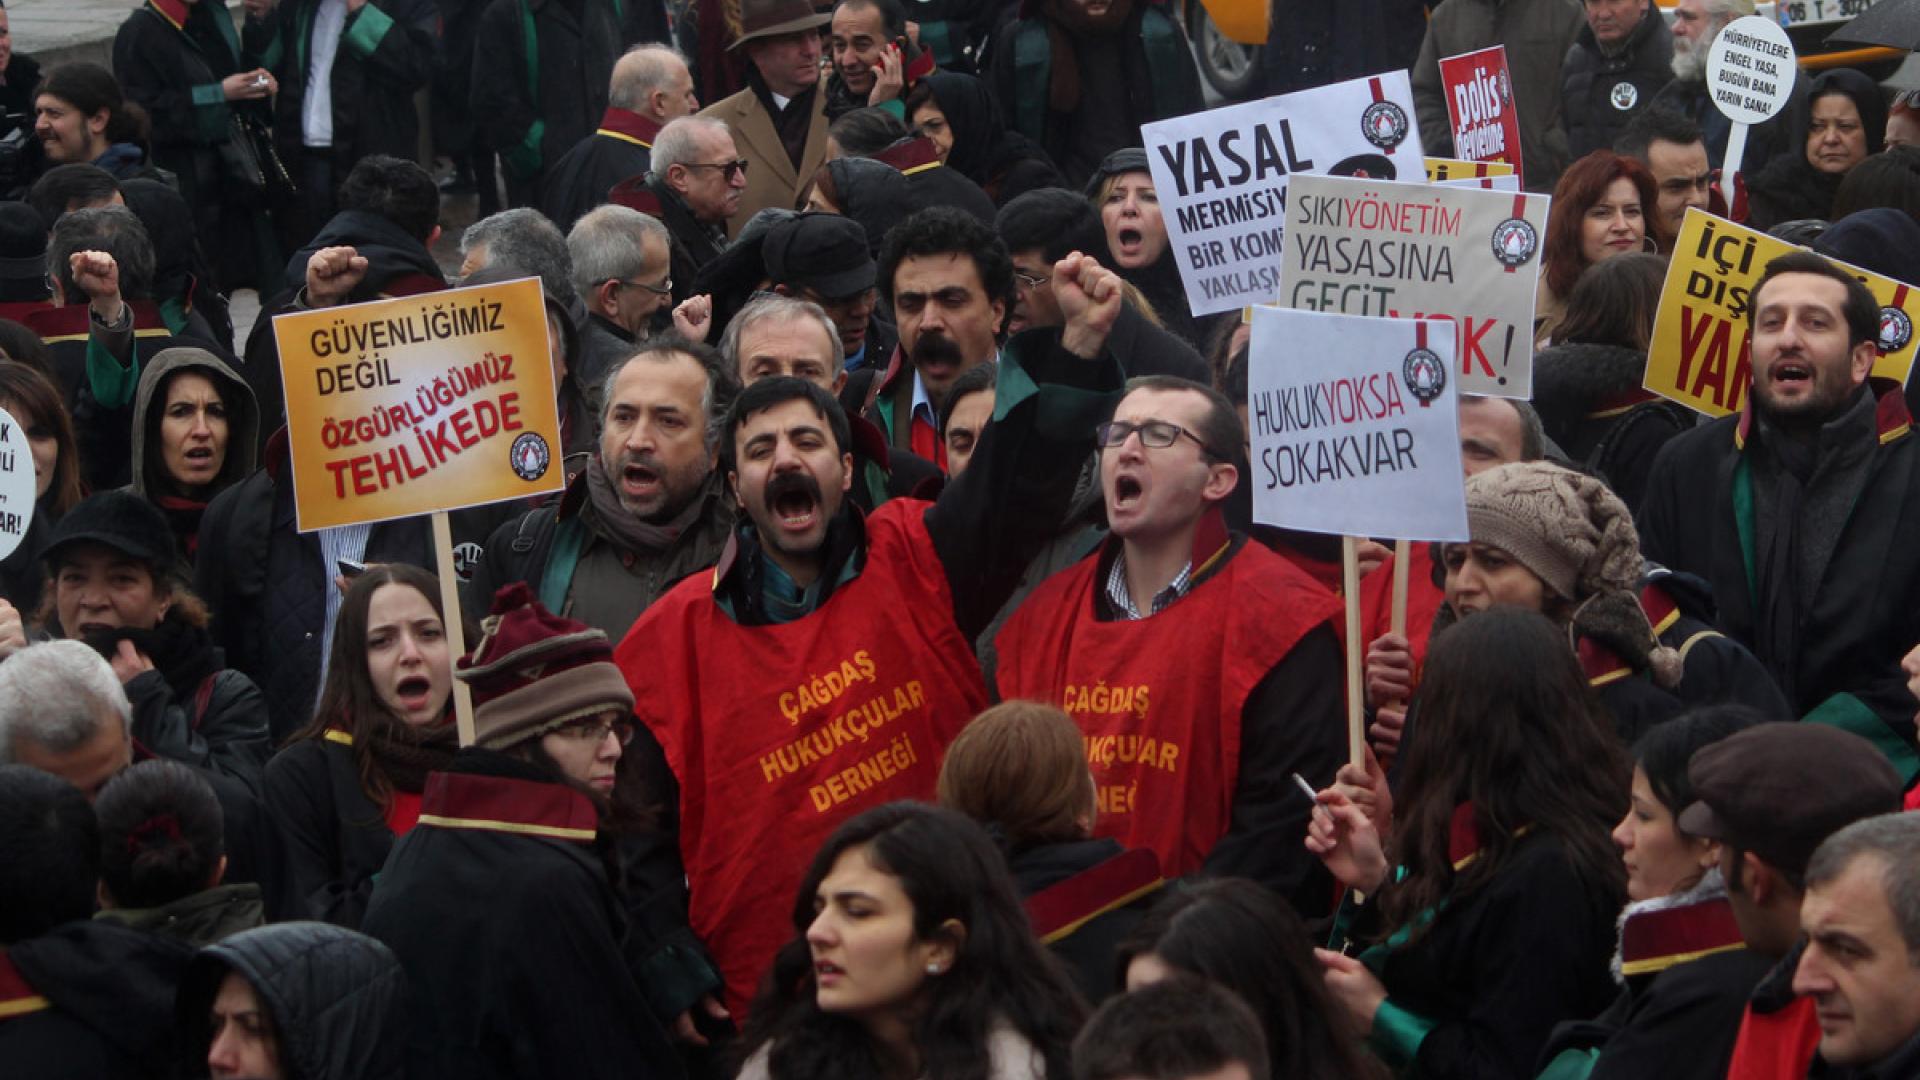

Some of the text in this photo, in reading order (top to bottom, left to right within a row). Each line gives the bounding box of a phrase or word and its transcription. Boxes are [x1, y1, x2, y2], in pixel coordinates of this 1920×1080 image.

[1718, 69, 1777, 97] BUGÜN BANA
[1724, 50, 1779, 79] ENGEL YASA,
[1455, 67, 1501, 133] polis
[1716, 88, 1772, 115] YARIN SANA!
[1157, 118, 1315, 197] YASAL
[1296, 232, 1455, 284] YASASINA
[311, 298, 505, 358] GÜVENLİĞİMİZ
[316, 352, 401, 396] DEĞİL
[321, 351, 516, 450] ÖZGÜRLÜĞÜMÜZ
[325, 391, 524, 499] TEHLİKEDE
[778, 649, 876, 727] ÇAĞDAŞ
[759, 680, 926, 784] HUKUKÇULAR
[809, 731, 918, 814] DERNEĞİ
